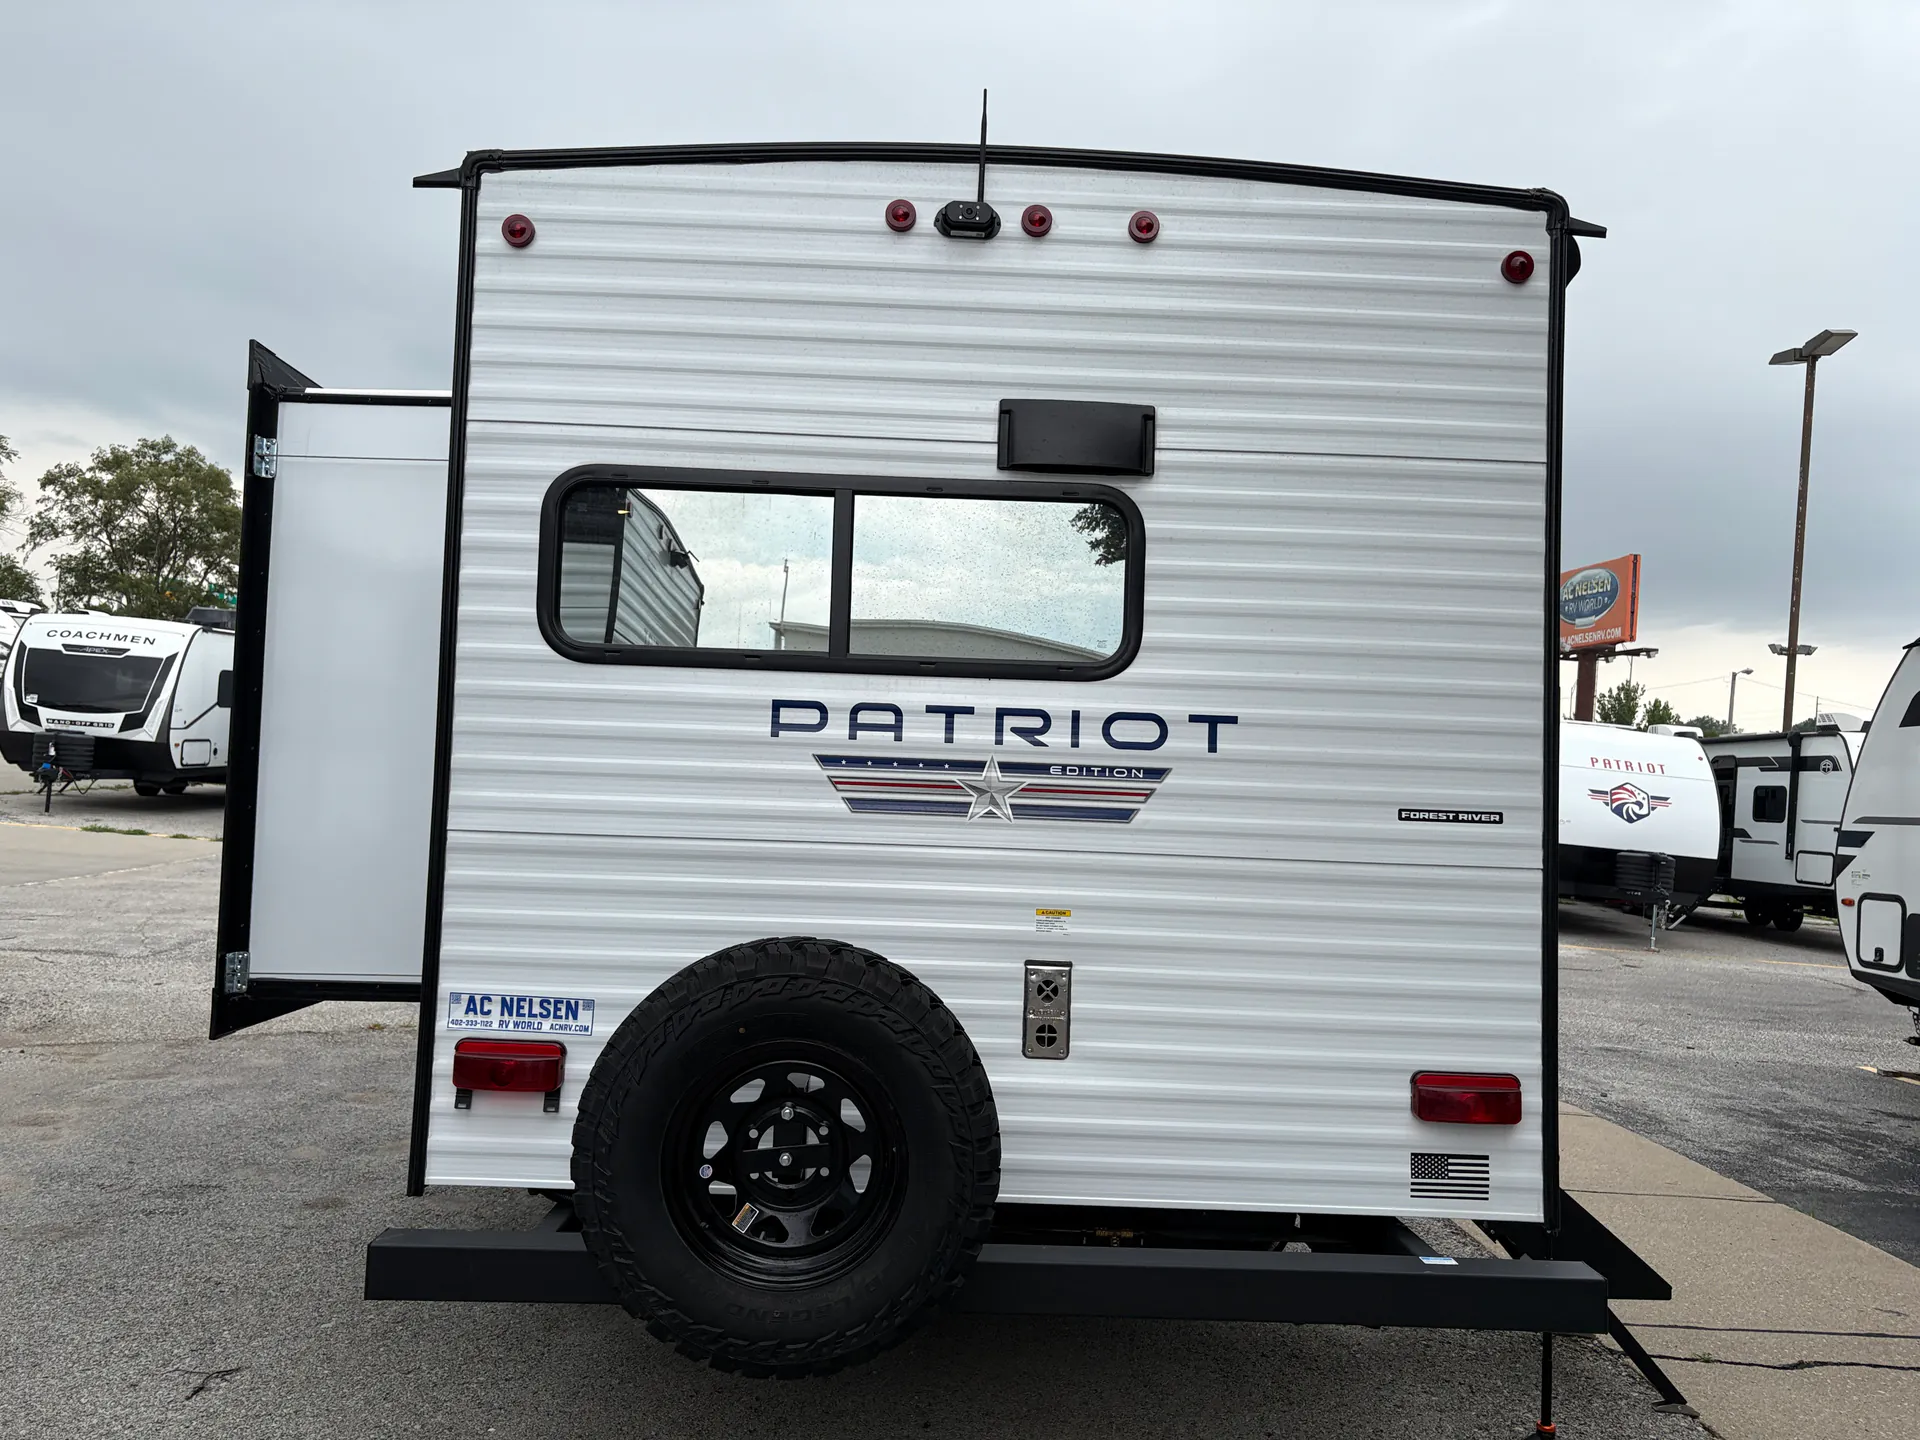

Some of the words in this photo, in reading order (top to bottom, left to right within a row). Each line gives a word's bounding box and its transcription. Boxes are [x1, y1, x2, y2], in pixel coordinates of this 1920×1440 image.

[1563, 587, 1574, 601] AC
[1575, 578, 1611, 597] NELSEN
[1568, 602, 1577, 614] RV
[1578, 597, 1602, 612] WORLD
[46, 629, 156, 645] COACHMEN
[770, 699, 1238, 753] PATRIOT
[1049, 764, 1144, 779] EDITION
[1590, 757, 1665, 774] PATRIOT
[1401, 811, 1455, 820] FOREST
[1458, 813, 1500, 822] RIVER
[464, 995, 492, 1016] AC
[500, 997, 579, 1020] NELSEN
[450, 1019, 493, 1027] 402-333-1122
[498, 1019, 510, 1029] RV
[513, 1021, 543, 1031] WORLD
[549, 1023, 589, 1033] ACNRV.COM
